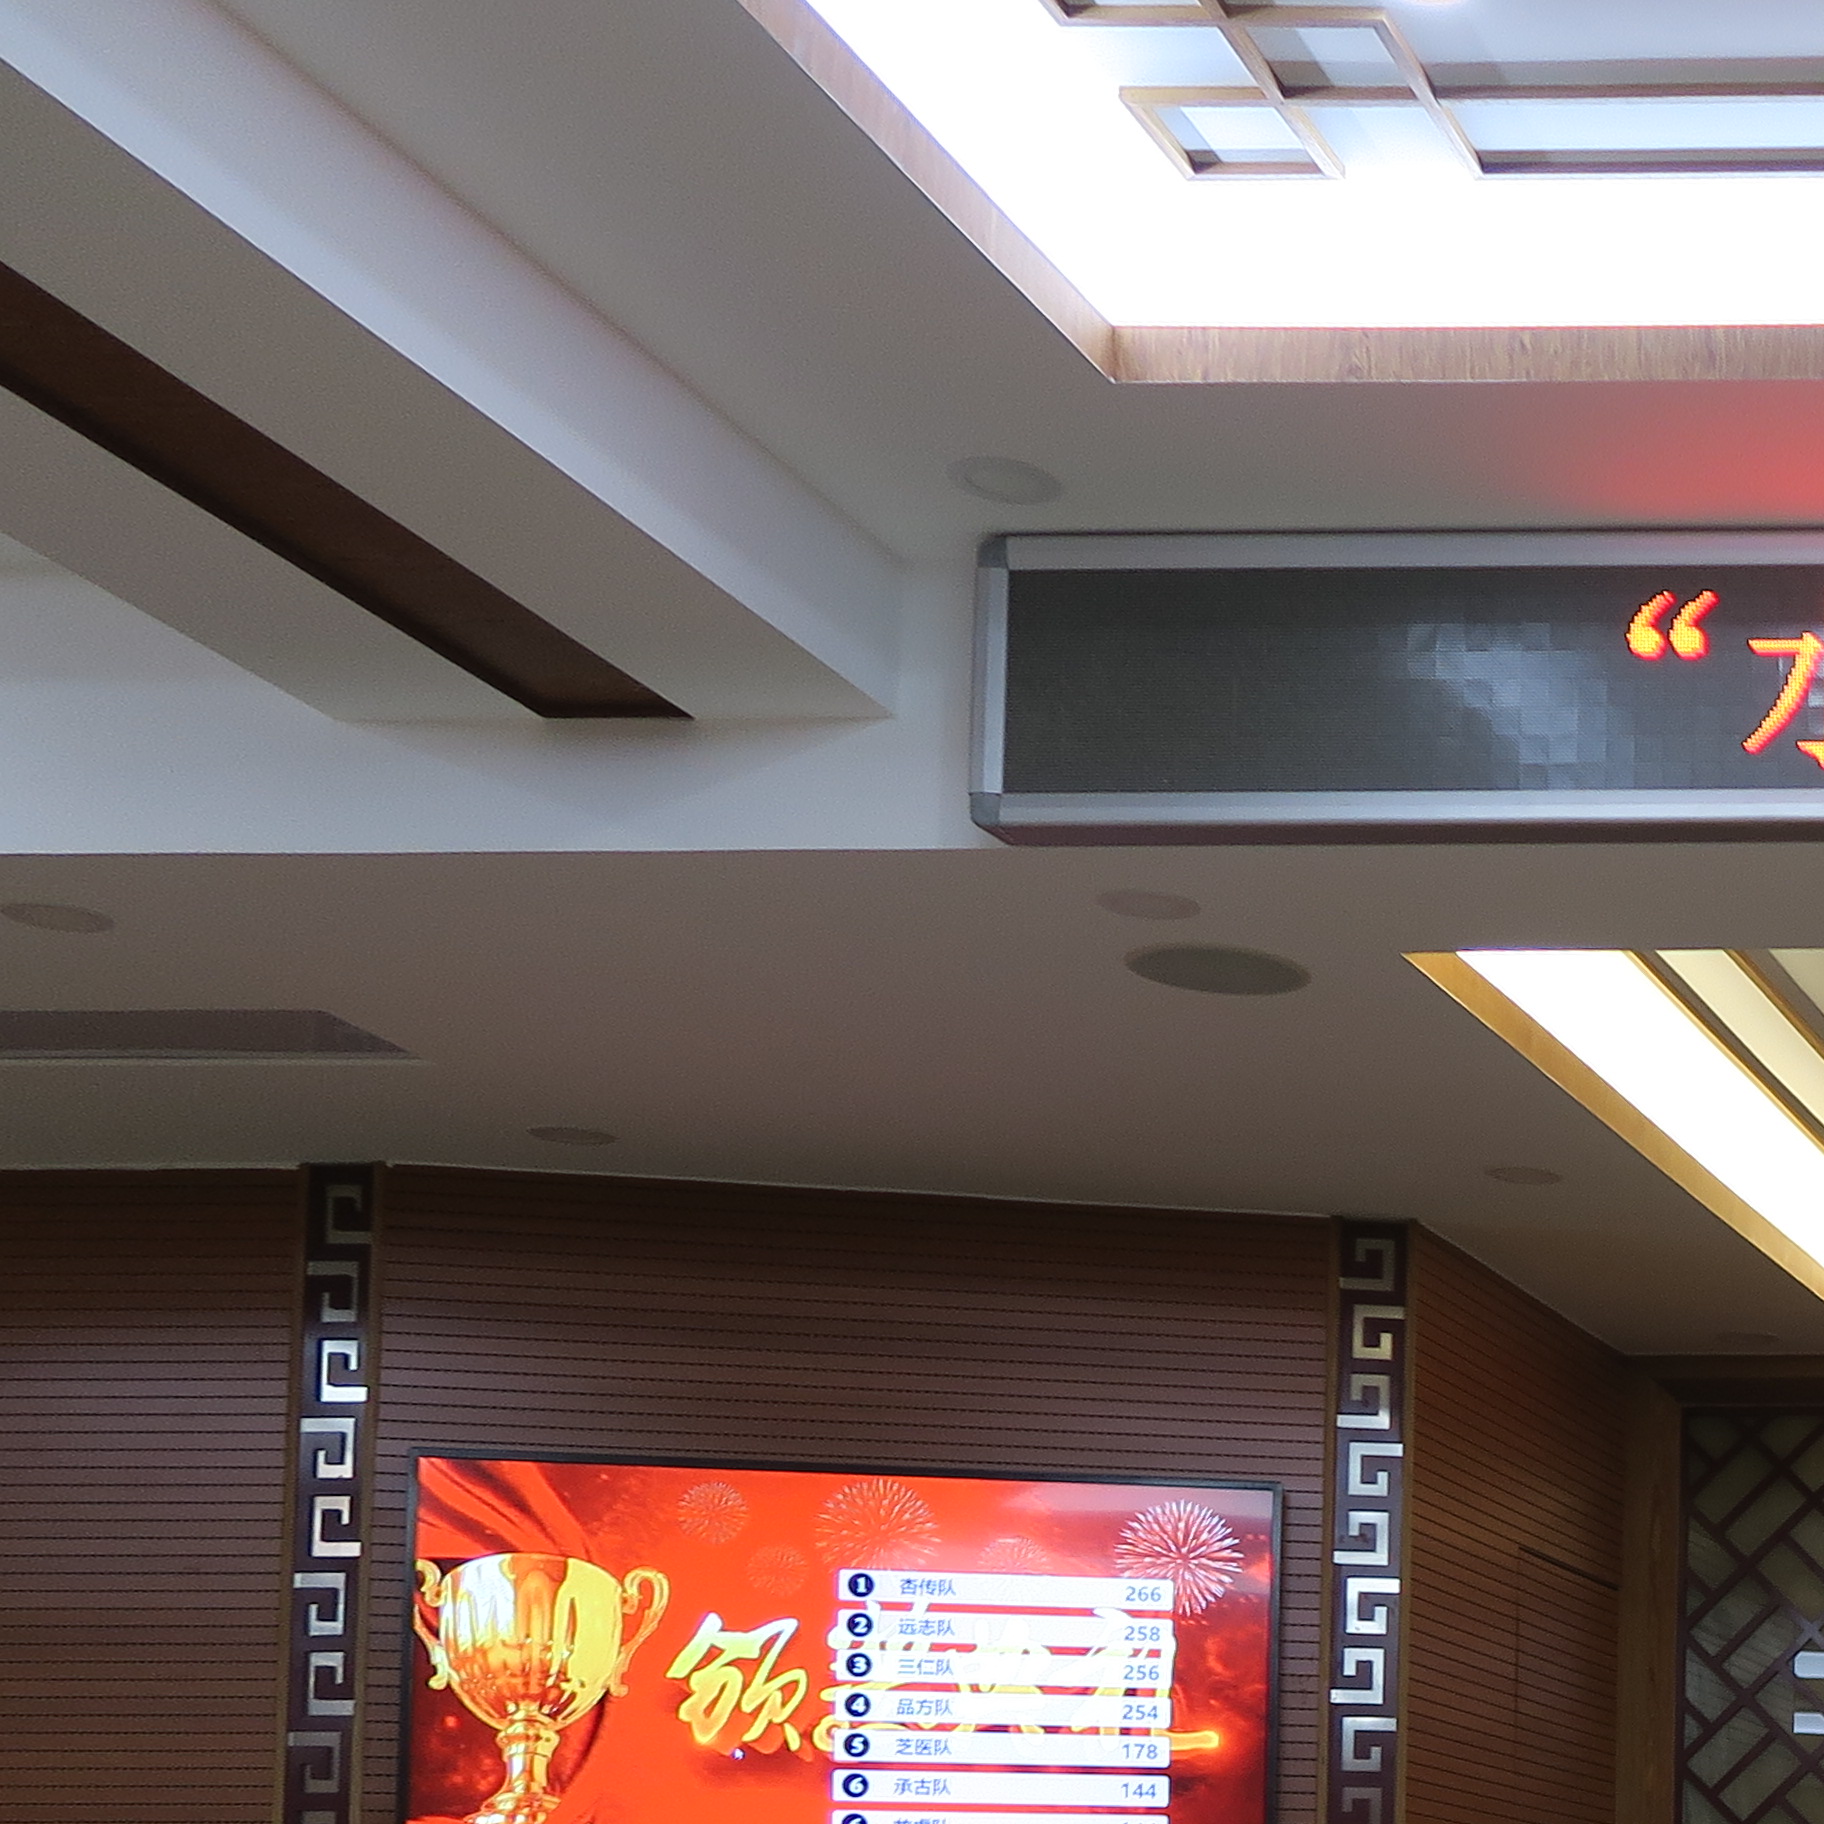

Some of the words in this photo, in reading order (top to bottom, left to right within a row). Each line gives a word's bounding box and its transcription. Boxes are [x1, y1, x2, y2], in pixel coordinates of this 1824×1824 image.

[1125, 1586, 1162, 1603] 266
[898, 1618, 956, 1636] 远志队
[1124, 1625, 1161, 1642] 258
[897, 1658, 954, 1676] 三仁队
[1123, 1665, 1160, 1681] 256
[896, 1698, 953, 1716] 品方队
[1122, 1704, 1159, 1722] 254
[894, 1738, 952, 1757] 芝医队
[1121, 1743, 1158, 1760] 178
[1120, 1783, 1157, 1800] 144
